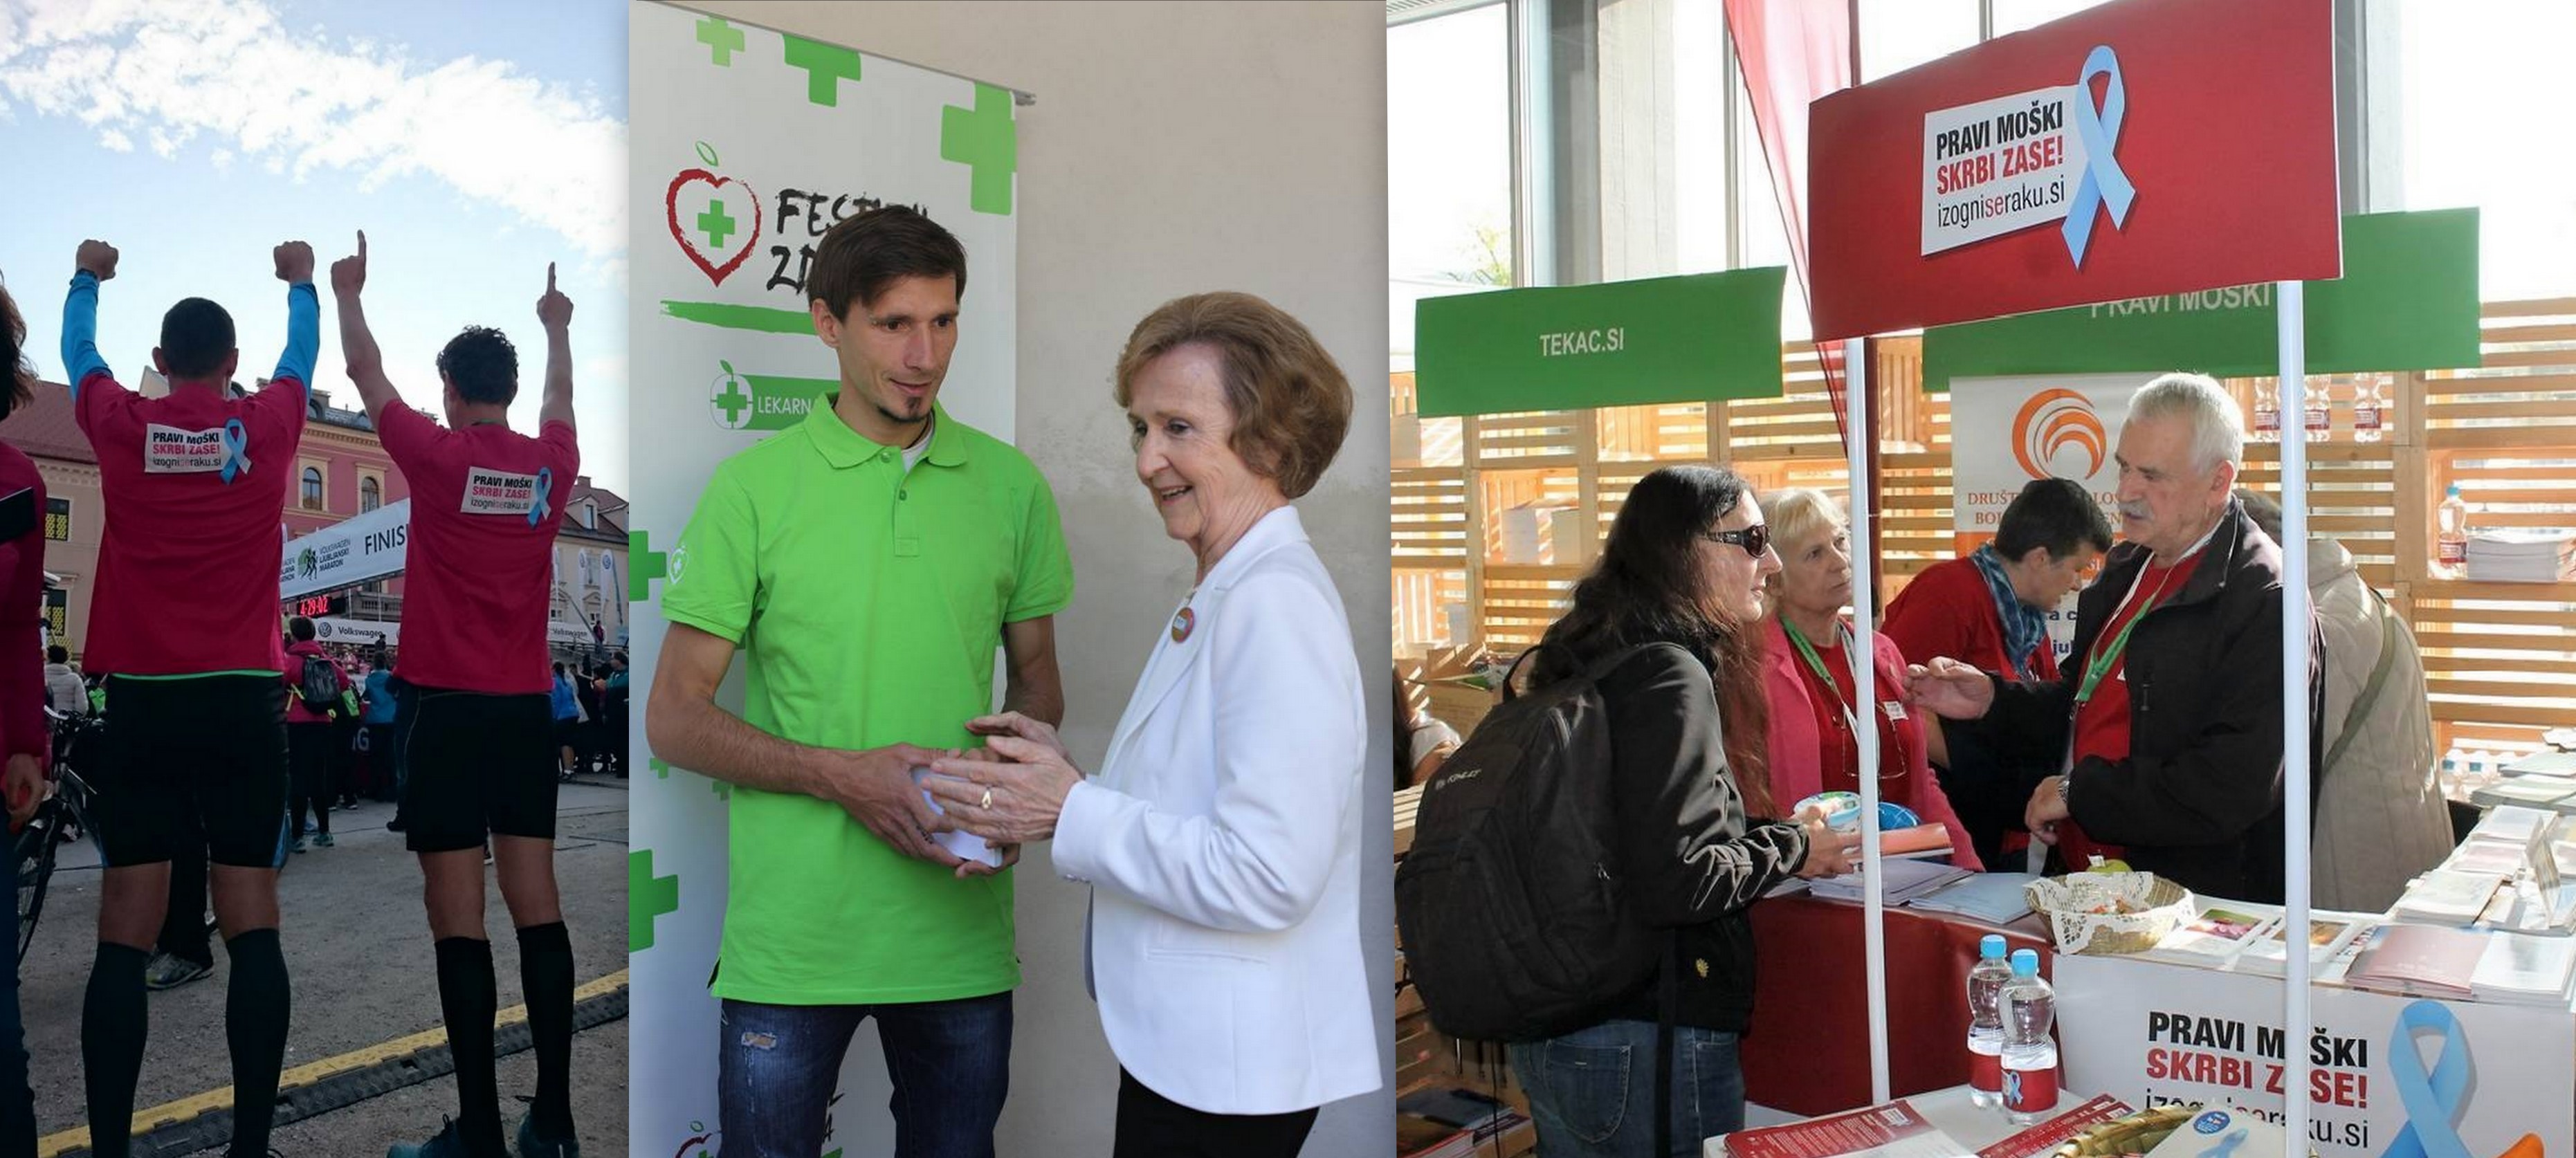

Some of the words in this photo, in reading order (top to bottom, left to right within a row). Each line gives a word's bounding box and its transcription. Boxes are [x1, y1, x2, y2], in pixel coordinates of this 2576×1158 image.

[1937, 120, 1990, 160] PRAVI
[1997, 100, 2063, 144] MOŠKI
[1937, 153, 1995, 195] SKRBI
[2002, 135, 2063, 178] ZASE!
[1937, 174, 2065, 228] izogniseraku.si
[1539, 327, 1624, 356] TEKAC.SI
[758, 396, 812, 414] LEKARN
[152, 432, 183, 443] PRAVI
[186, 432, 220, 445] MOŠKI
[152, 443, 185, 455] SKRBI
[188, 443, 220, 455] ZASE!
[152, 457, 221, 468] izogniseraku.si
[473, 475, 502, 487] PRAVI
[504, 477, 533, 489] MOŠKI
[472, 486, 502, 497] SKRBI
[504, 488, 531, 499] ZASE!
[1968, 490, 2016, 505] DRUŠT
[471, 497, 530, 510] izogniseraku.si
[365, 524, 409, 555] FINIS
[319, 559, 344, 573] MARATON
[2148, 1011, 2245, 1052] PRAVI
[2256, 1026, 2368, 1067] MŠKI
[2146, 1048, 2252, 1089] SKRBI
[2265, 1064, 2368, 1109] ZSE!
